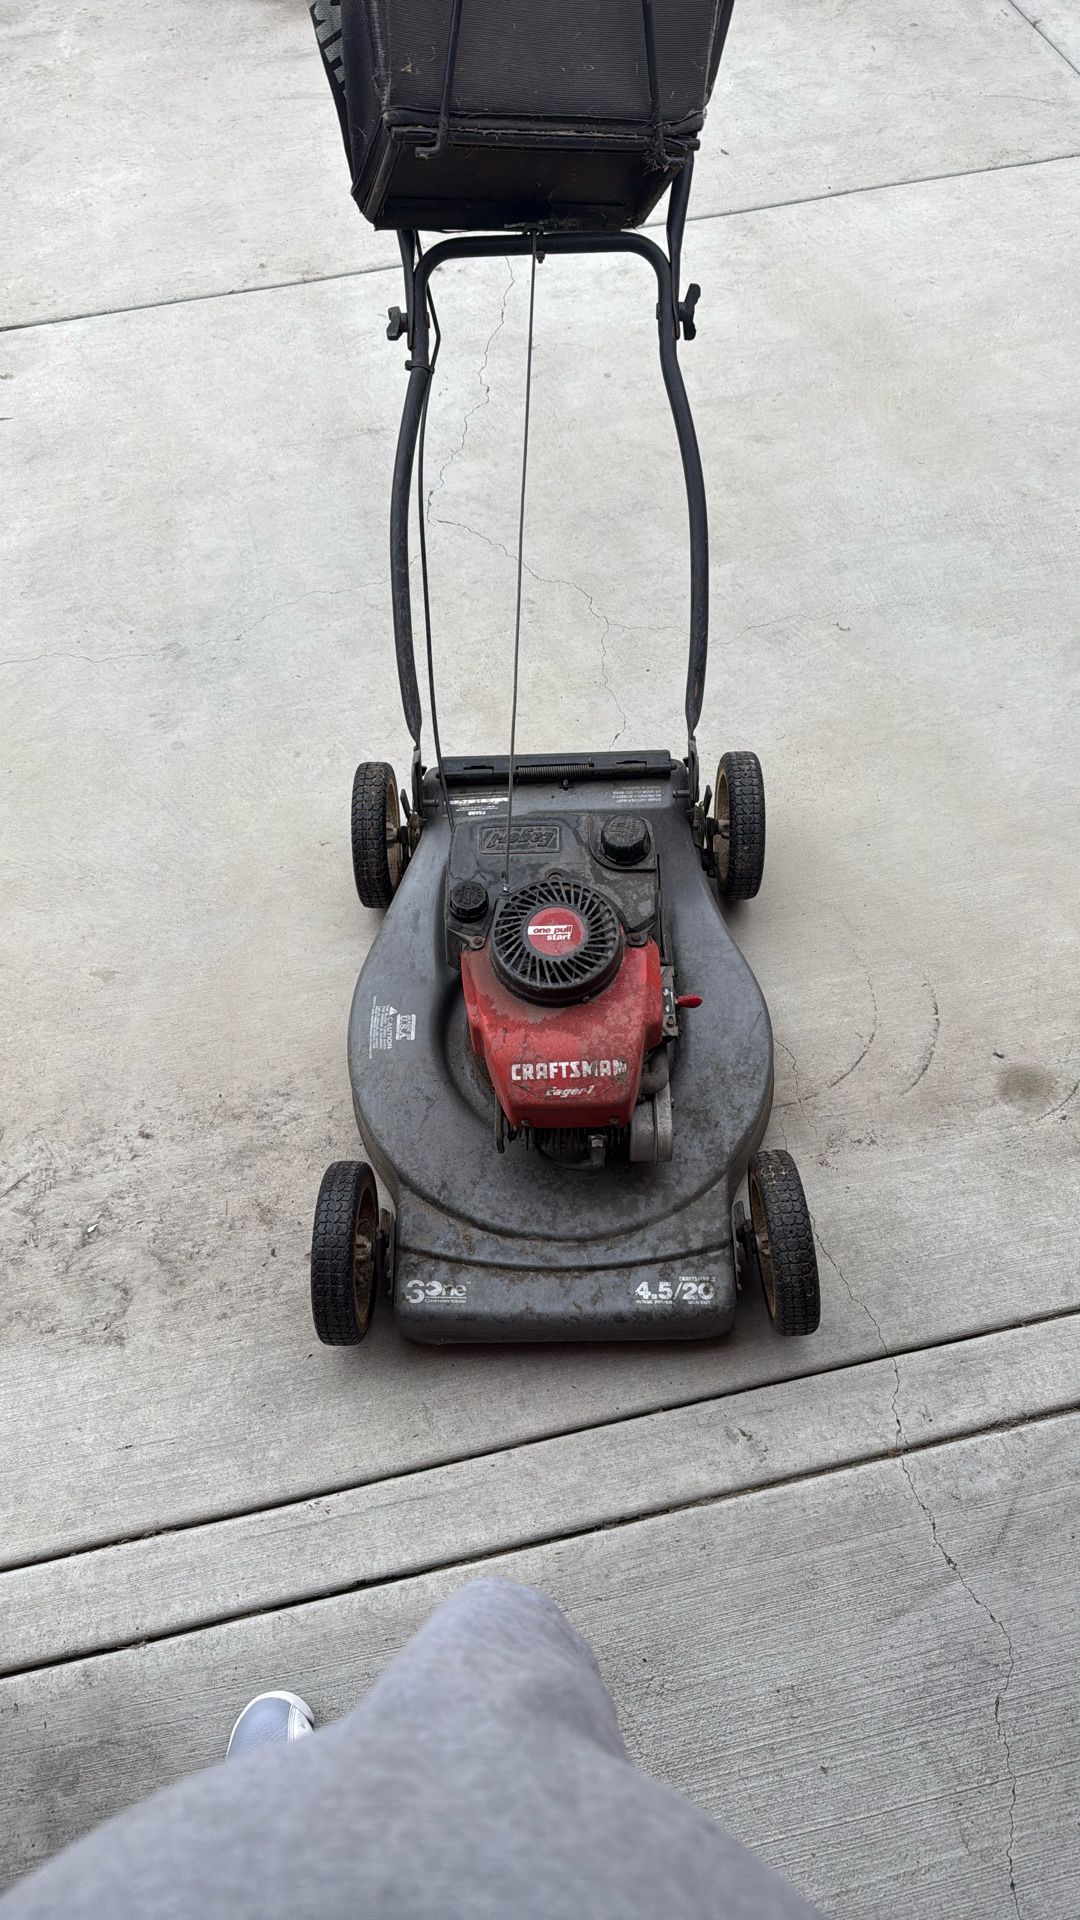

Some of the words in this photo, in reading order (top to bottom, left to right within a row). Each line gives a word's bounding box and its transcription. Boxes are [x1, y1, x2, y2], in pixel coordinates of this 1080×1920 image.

[486, 828, 554, 849] Eager-1
[546, 932, 571, 941] start
[553, 925, 571, 935] pull
[399, 1015, 407, 1040] U.S.A.
[511, 1059, 627, 1081] CRAFTSMAN
[635, 1281, 715, 1300] 4.5/20
